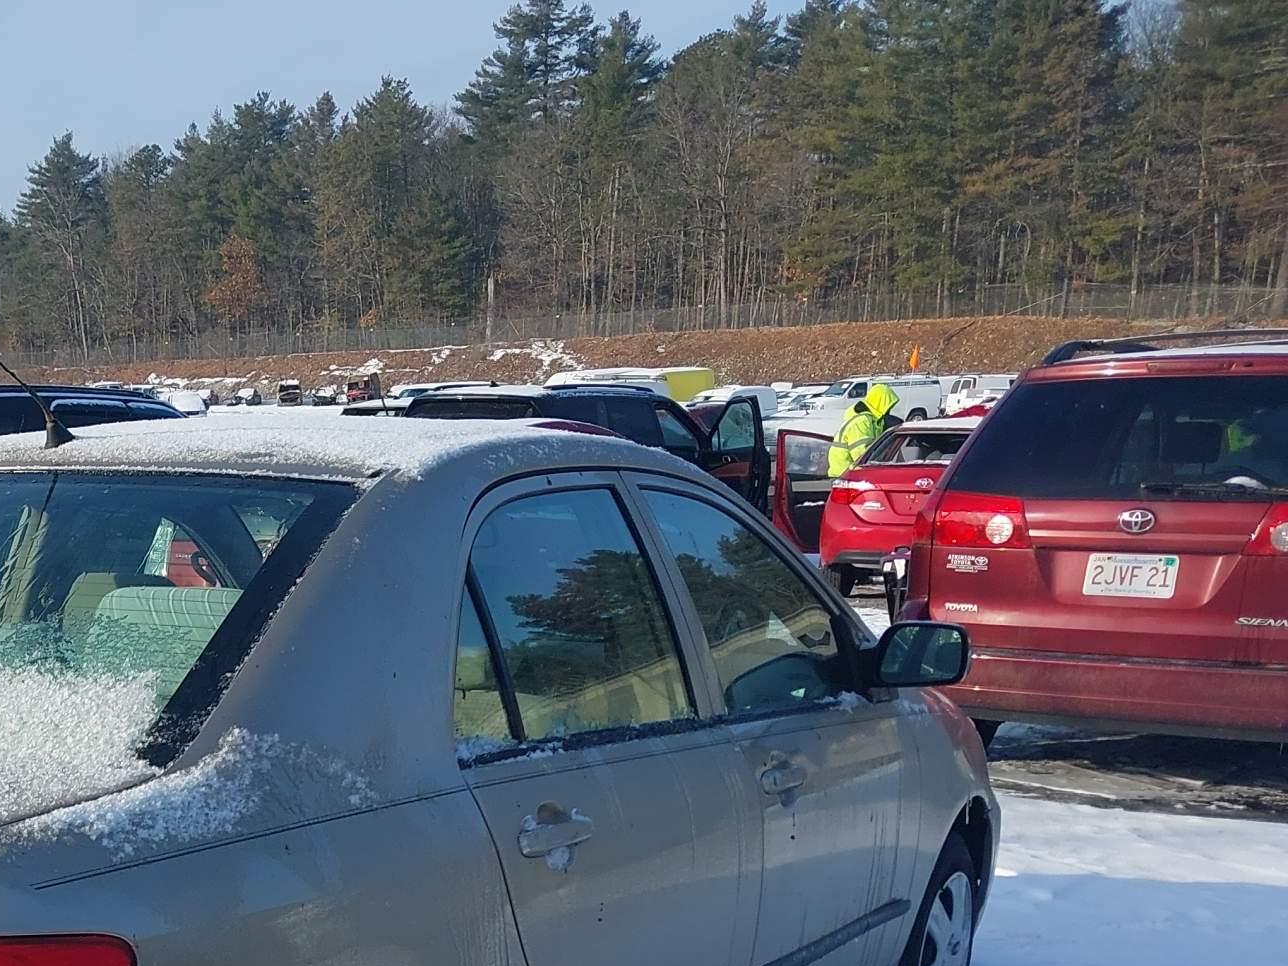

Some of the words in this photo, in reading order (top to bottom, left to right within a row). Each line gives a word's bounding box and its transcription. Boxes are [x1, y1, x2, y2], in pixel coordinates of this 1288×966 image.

[1091, 565, 1143, 586] 2JVF
[1146, 566, 1170, 588] 21
[944, 602, 978, 613] TOYOTA
